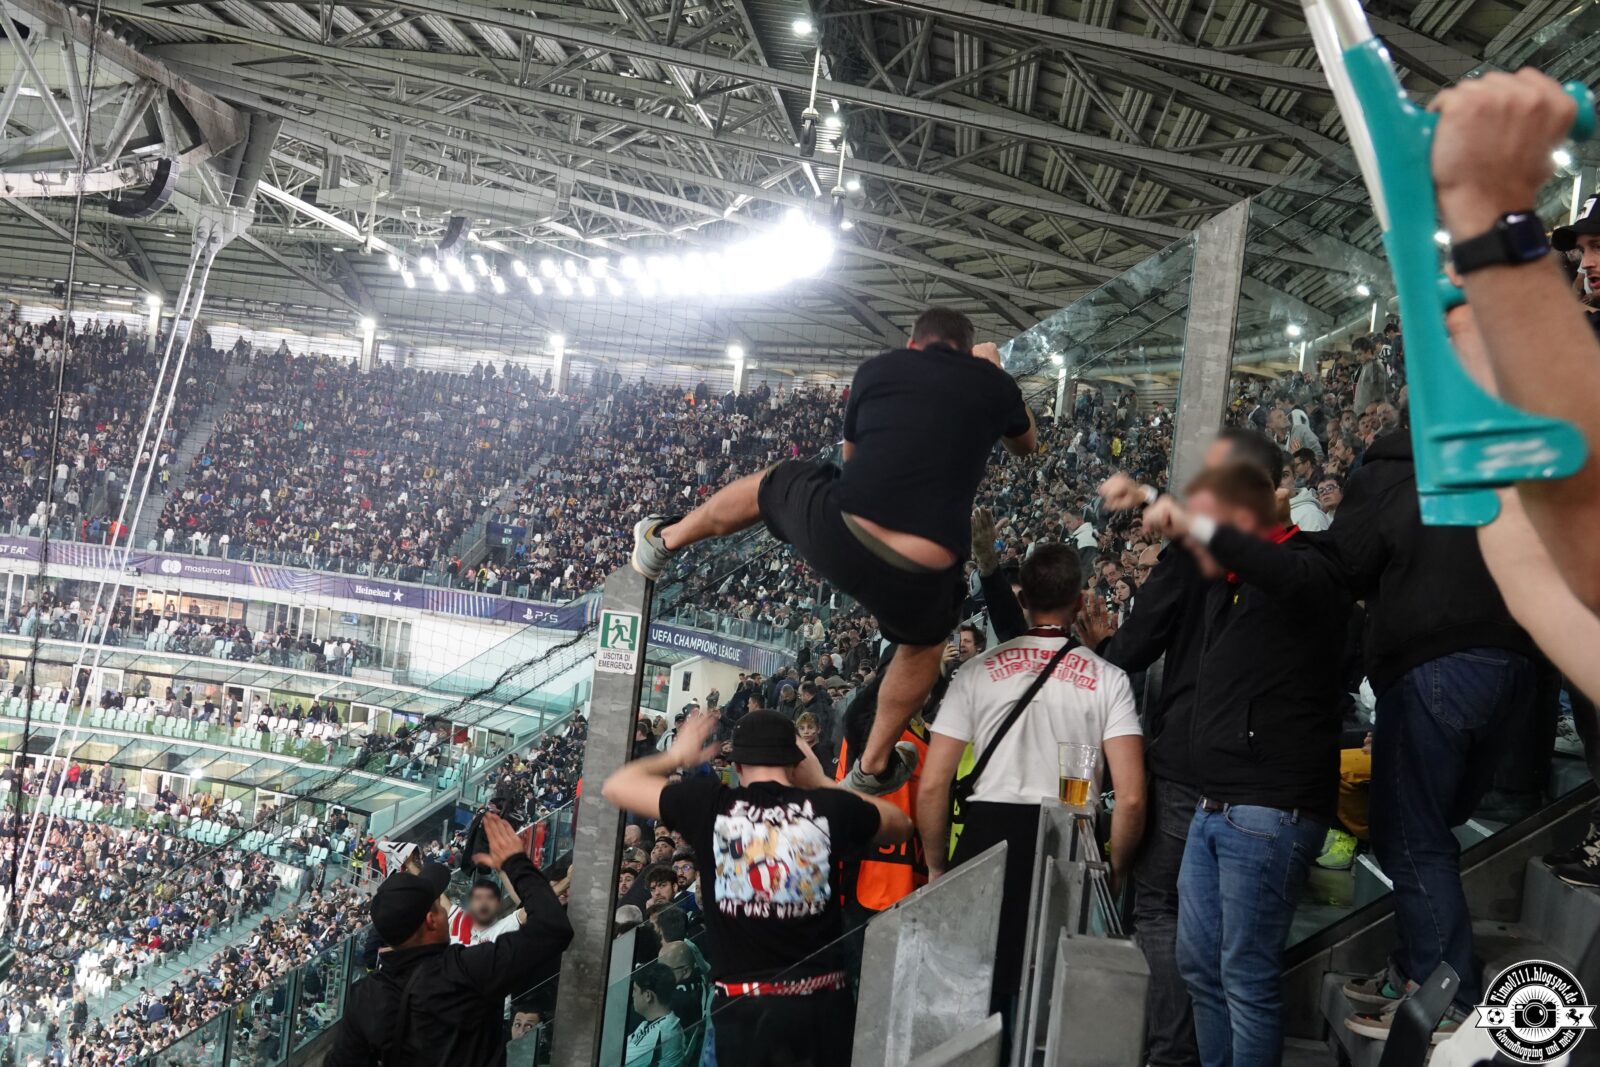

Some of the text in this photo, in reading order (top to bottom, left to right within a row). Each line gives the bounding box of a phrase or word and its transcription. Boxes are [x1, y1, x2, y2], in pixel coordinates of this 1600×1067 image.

[10, 545, 29, 555] EAT
[184, 565, 231, 576] mastercard
[355, 585, 390, 598] Heineken
[534, 610, 559, 623] PS5
[651, 628, 741, 662] UEFA CHAMPIONS LEAGUE
[603, 651, 631, 662] USCITA DI
[598, 659, 633, 670] EMERGENZA
[729, 799, 815, 824] EUROPA
[743, 901, 770, 919] UNS
